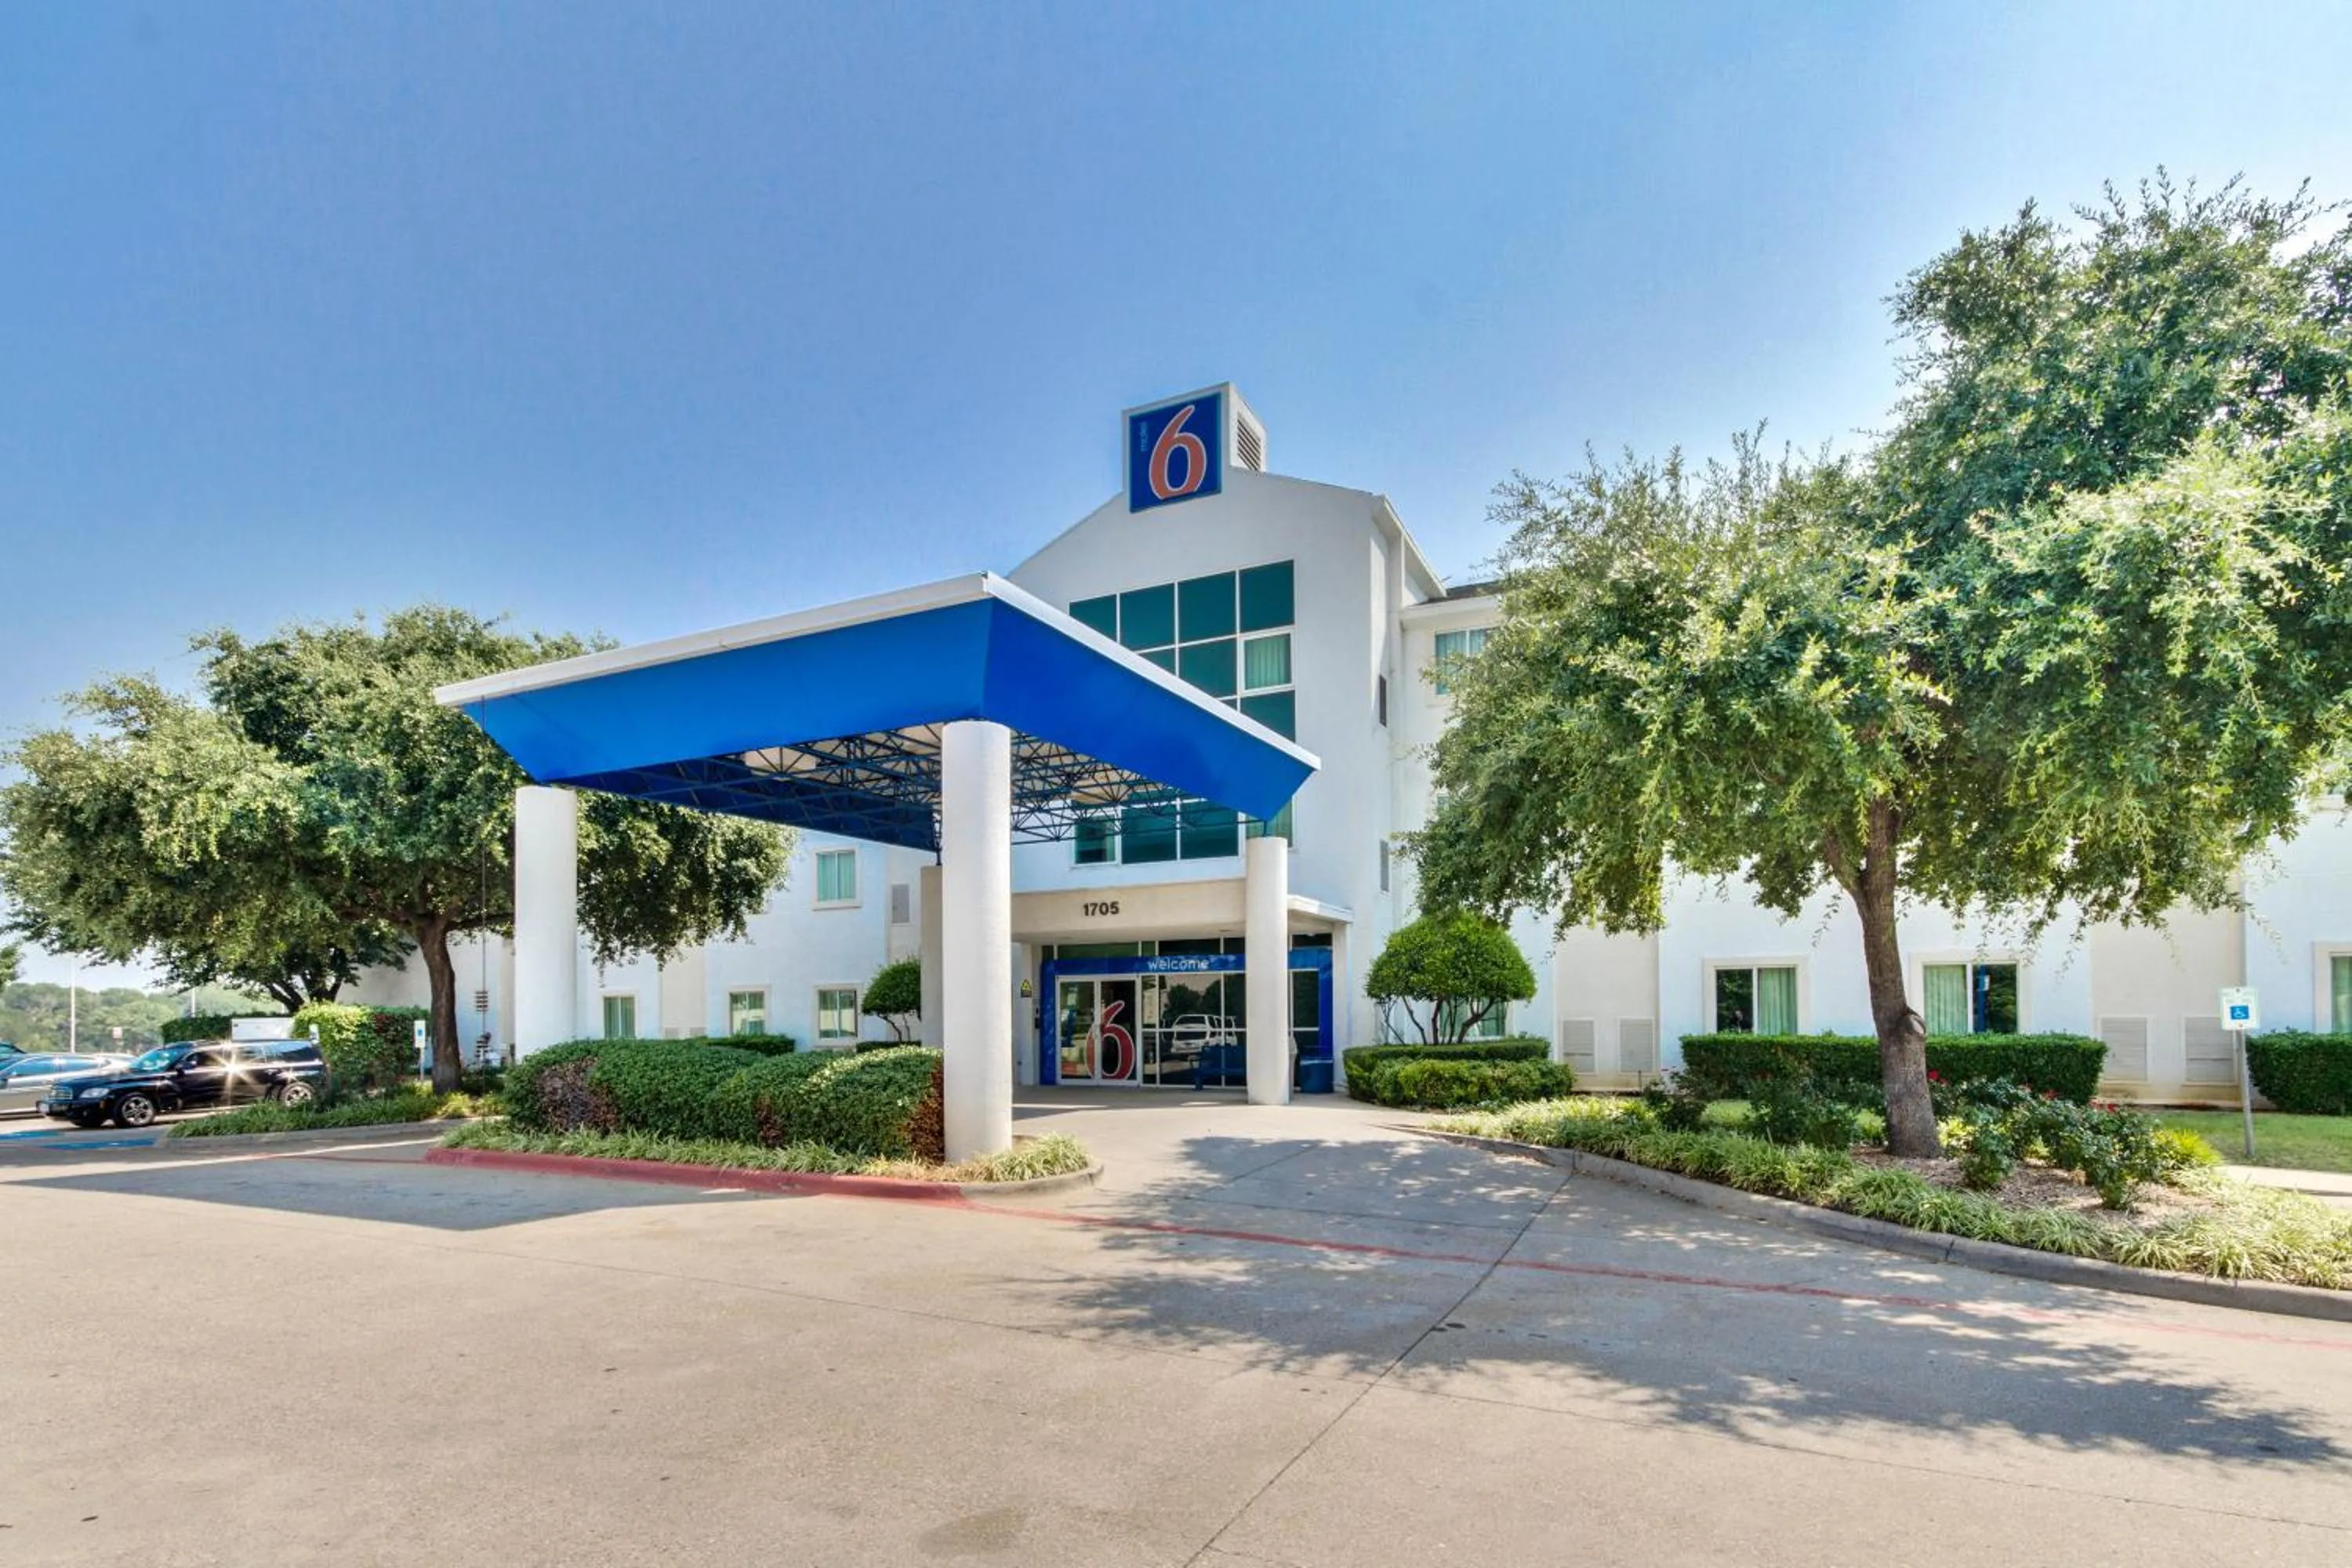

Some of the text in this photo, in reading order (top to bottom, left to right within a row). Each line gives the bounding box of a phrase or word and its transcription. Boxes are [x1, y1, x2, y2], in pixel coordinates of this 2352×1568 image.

[1149, 404, 1207, 500] 6
[1083, 901, 1120, 916] 1705
[1147, 956, 1209, 971] welcome
[1085, 1000, 1136, 1080] 6
